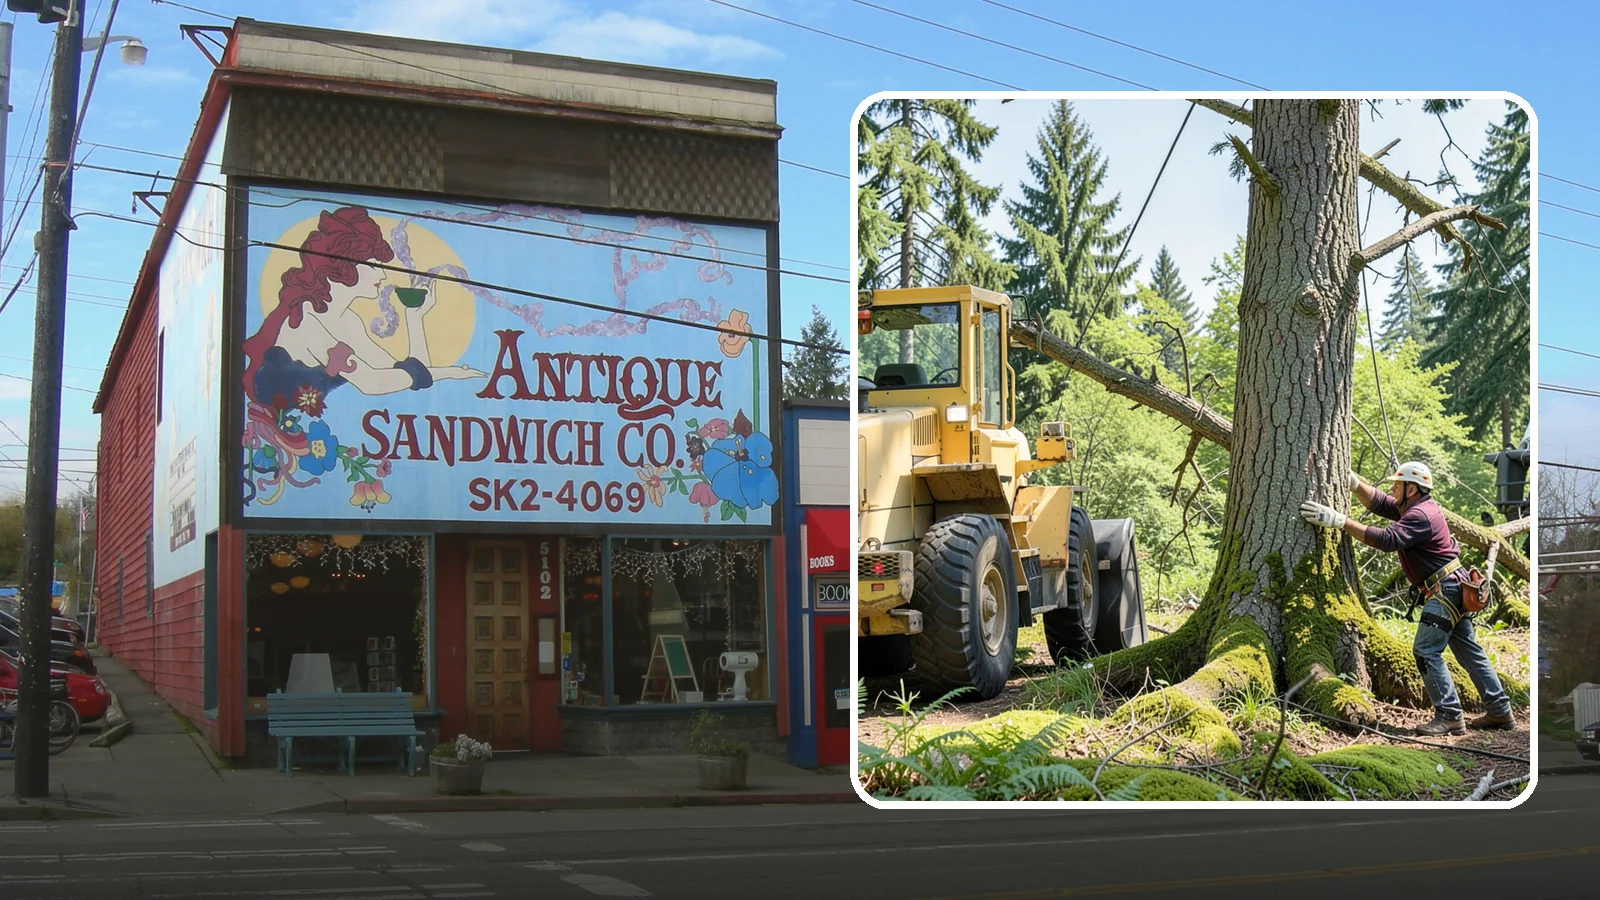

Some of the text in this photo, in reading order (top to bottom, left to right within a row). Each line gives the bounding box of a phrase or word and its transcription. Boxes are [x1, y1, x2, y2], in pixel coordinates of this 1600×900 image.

[476, 329, 724, 421] ANTIQUE
[362, 409, 685, 468] SANDWICH CO.
[469, 477, 645, 513] SK2-4069
[540, 542, 551, 599] 5102
[809, 555, 835, 569] BOOKS
